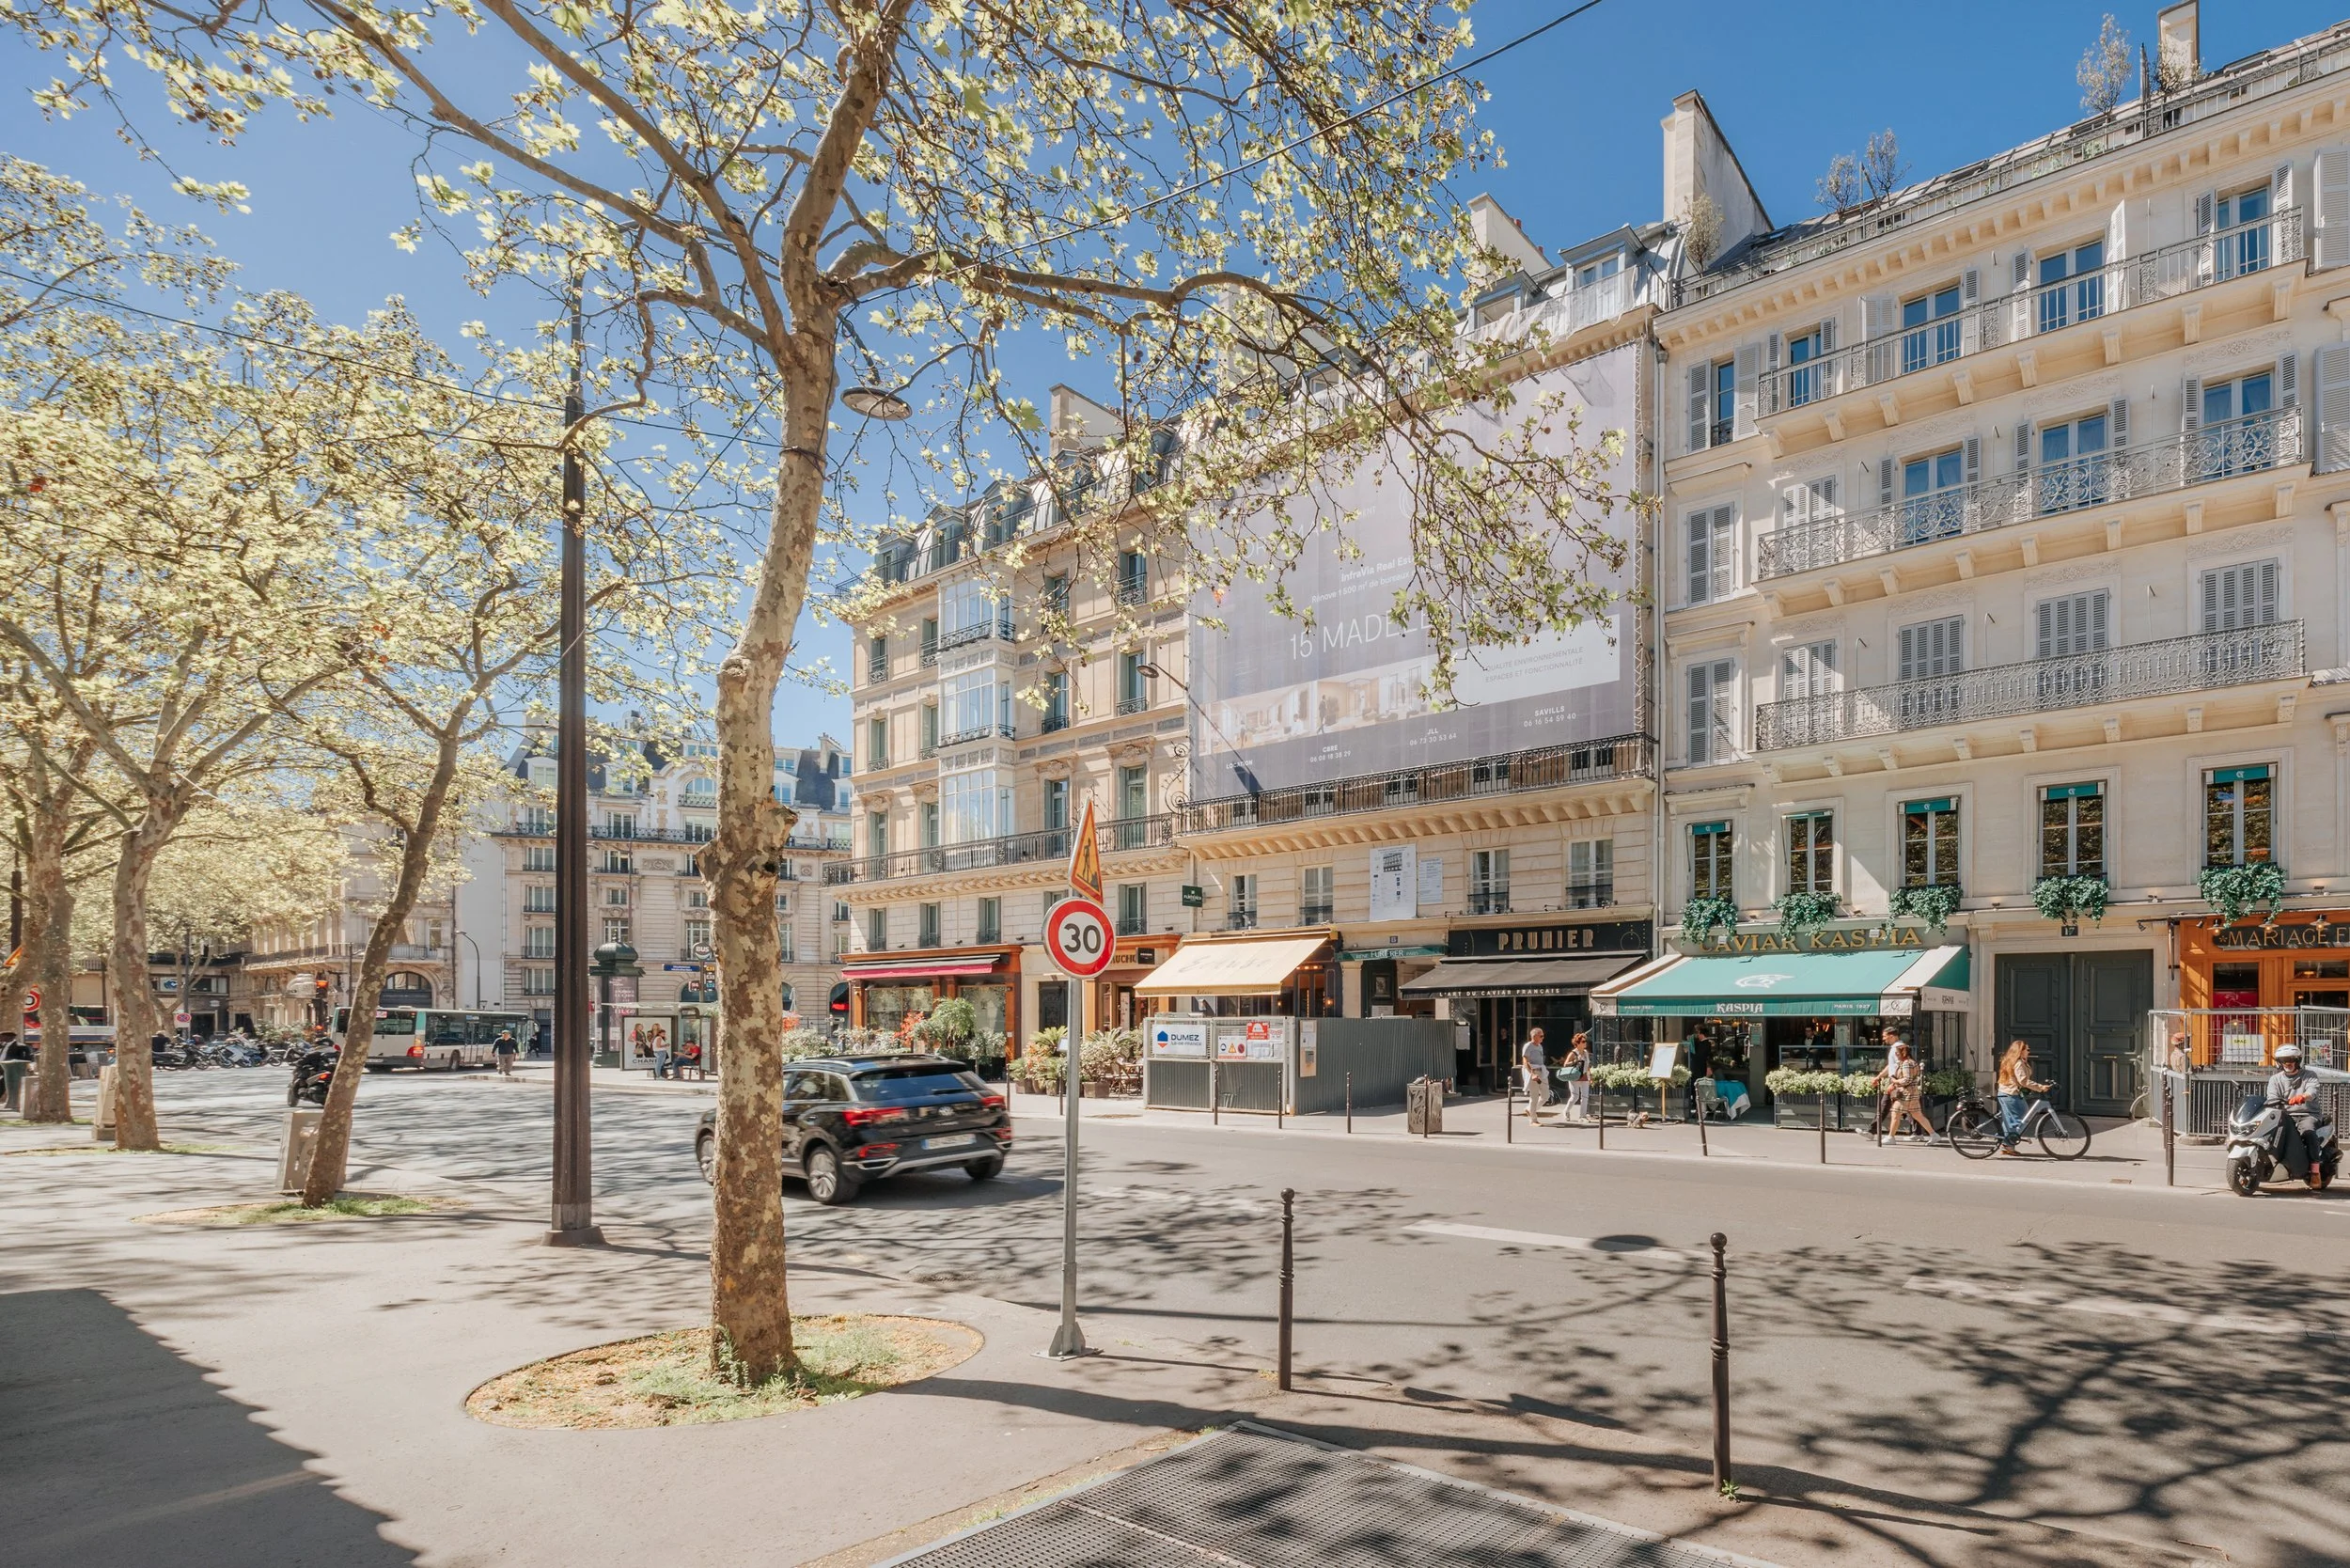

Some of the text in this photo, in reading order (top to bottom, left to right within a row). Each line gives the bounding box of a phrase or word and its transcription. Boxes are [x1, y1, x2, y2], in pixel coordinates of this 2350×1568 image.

[1341, 566, 1374, 583] InfraVia
[1376, 559, 1396, 572] Real
[1289, 630, 1313, 660] 15
[1514, 646, 1584, 666] ENVIRONNEMENTALE
[1515, 668, 1523, 677] ET
[1534, 705, 1565, 717] SAVILLS
[1063, 923, 1102, 954] 30
[1498, 929, 1594, 951] PRUNIER
[1810, 927, 1922, 949] KASPIA
[2064, 927, 2076, 935] 17
[2227, 927, 2329, 947] MARIAGE
[1716, 1002, 1763, 1012] KASPIA
